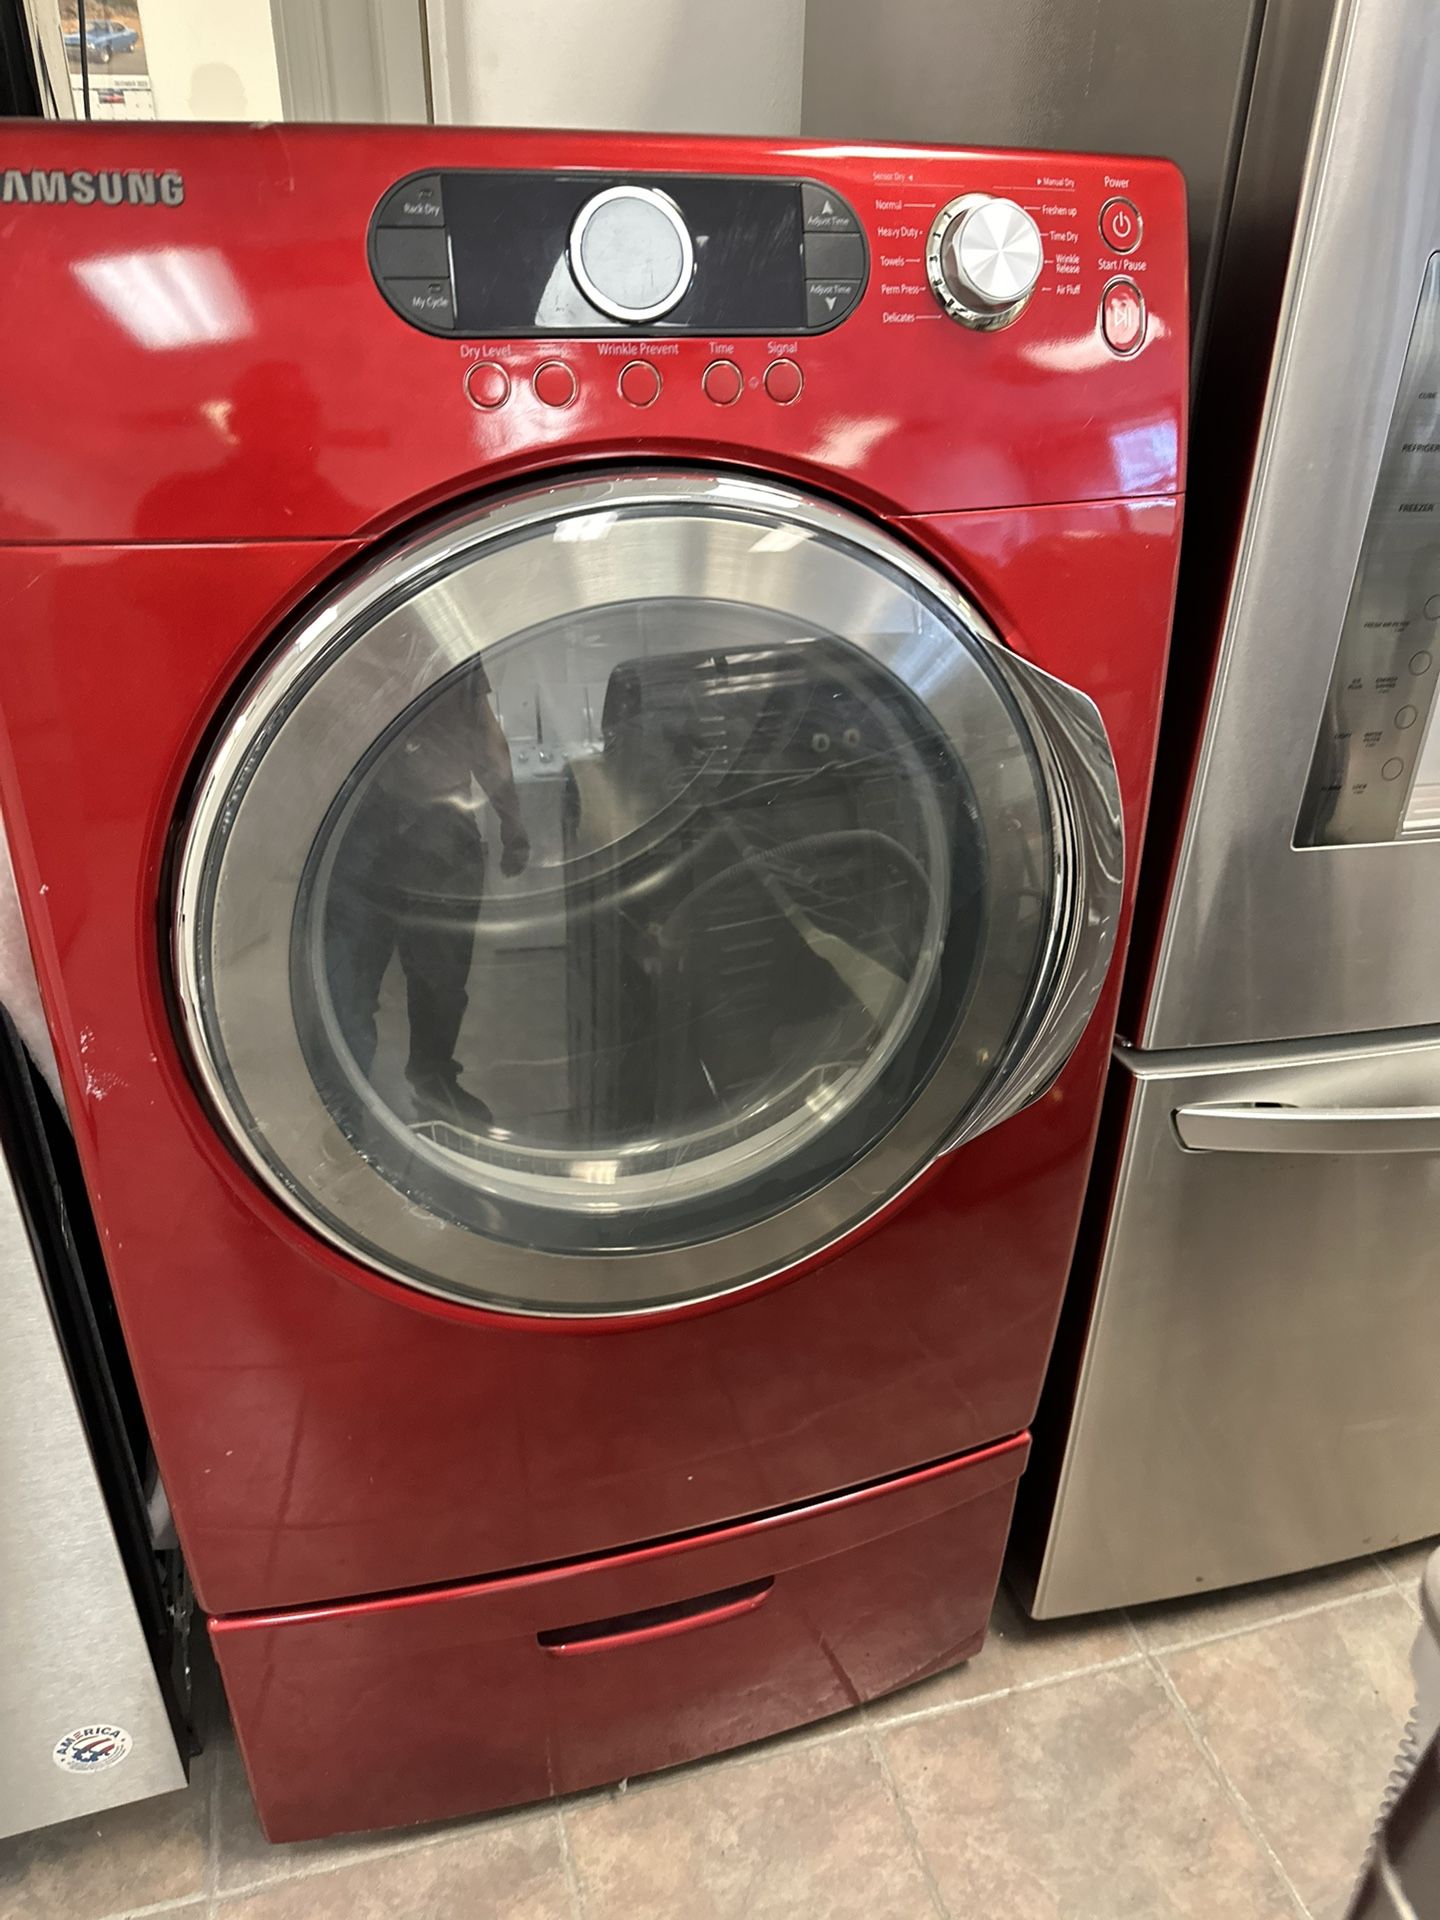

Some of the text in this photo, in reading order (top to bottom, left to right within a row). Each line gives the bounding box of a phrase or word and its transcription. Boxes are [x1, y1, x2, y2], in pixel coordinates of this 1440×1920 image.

[873, 172, 905, 182] Sensor Dry
[1043, 177, 1075, 188] Manual Dry
[1104, 176, 1130, 188] Power
[2, 169, 185, 206] AMSUNG
[403, 203, 440, 216] Rack Dry
[875, 199, 902, 210] Normal
[1042, 204, 1077, 217] Freshen up
[807, 215, 849, 227] Adjust Time
[877, 227, 918, 239] Heavy Duty
[1049, 231, 1078, 244] Time Dry
[880, 255, 905, 267] Towels
[1055, 254, 1080, 264] Wrinkle
[1097, 258, 1118, 270] Start
[1123, 259, 1147, 271] Pause
[1055, 263, 1080, 274] Release
[809, 284, 852, 296] Adjust Time
[881, 283, 920, 295] Perm Press
[1056, 284, 1081, 294] Air Fluff
[412, 296, 449, 309] My Cycle
[882, 312, 916, 323] Delicates
[459, 344, 512, 360] Dry Level
[597, 343, 679, 355] Wrinkle Prevent
[709, 342, 734, 354] Time
[767, 341, 798, 356] Signal
[1398, 503, 1435, 513] FREEZER
[56, 1727, 121, 1755] AMERICA
